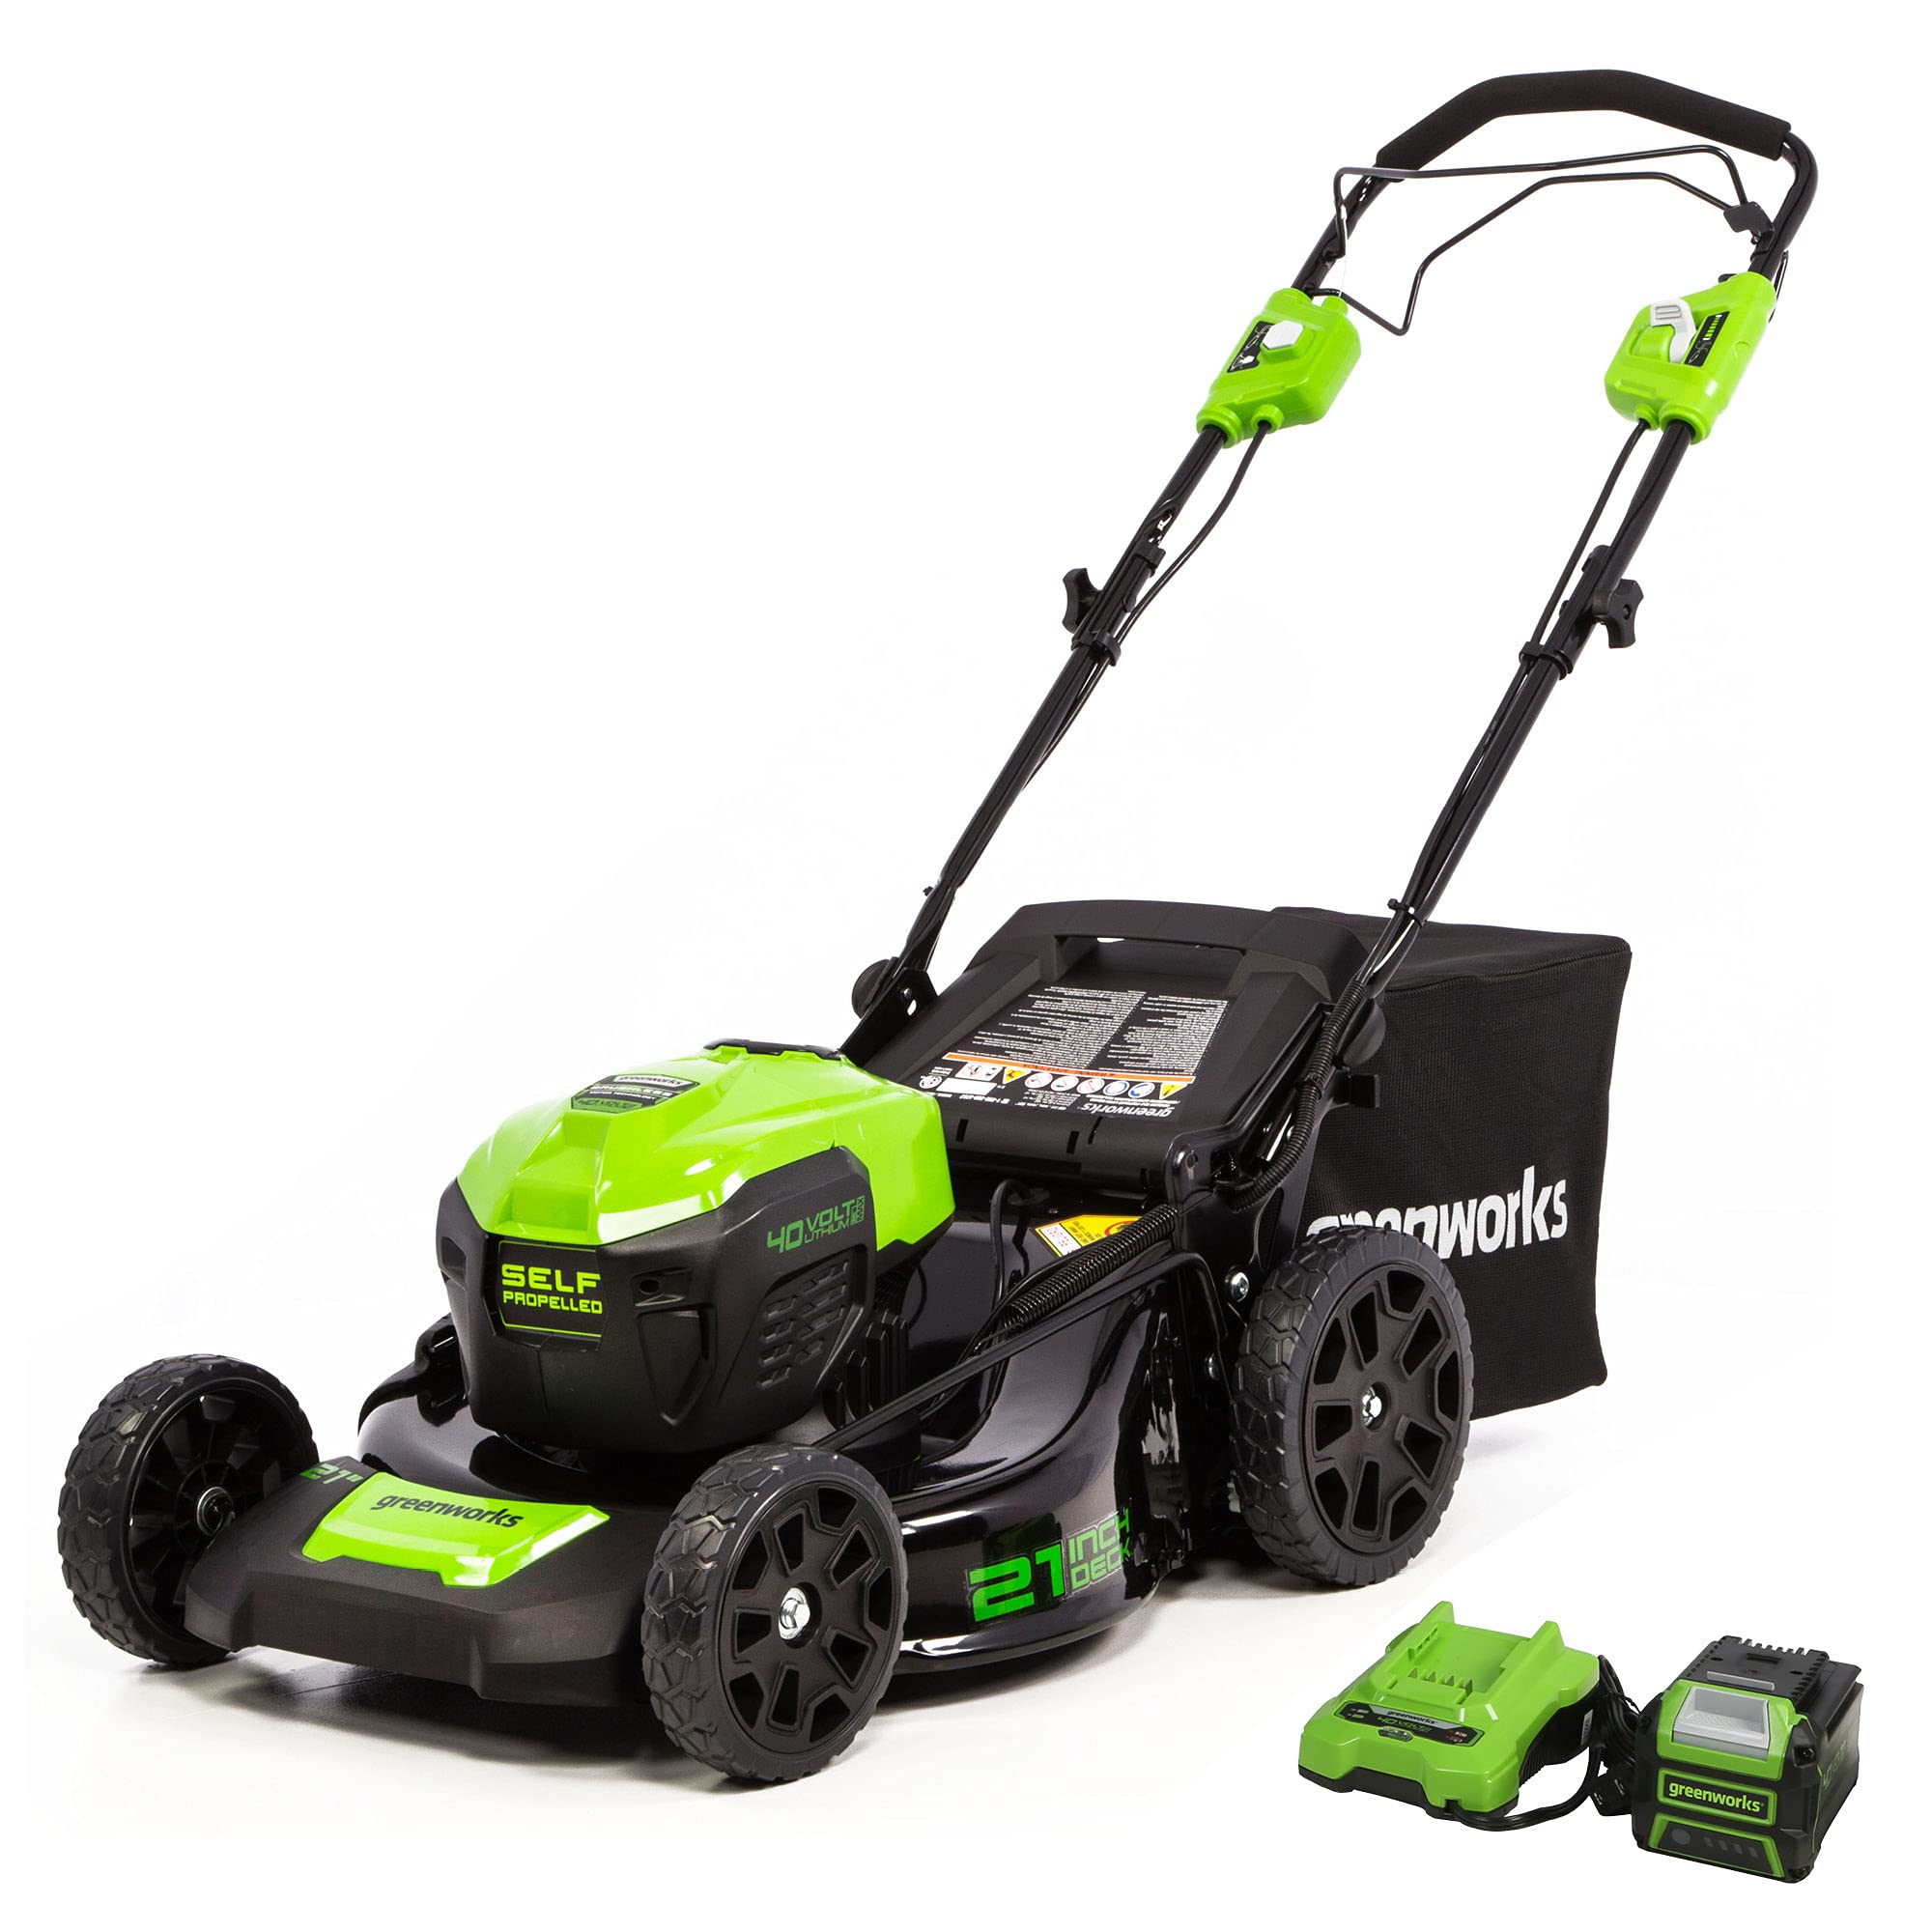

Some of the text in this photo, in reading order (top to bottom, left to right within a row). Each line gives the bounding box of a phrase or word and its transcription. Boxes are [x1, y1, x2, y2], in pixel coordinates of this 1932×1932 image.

[1081, 1103, 1175, 1118] greenworks
[766, 1199, 855, 1253] 40 VOLT
[1306, 1165, 1568, 1260] nworks
[804, 1217, 849, 1243] LITHIUM
[501, 1263, 601, 1294] SELF
[502, 1291, 603, 1315] PROPELLED
[370, 1494, 526, 1528] greenworks
[969, 1508, 1130, 1623] 21 INCH
[1071, 1537, 1132, 1590] DECK
[1387, 1710, 1437, 1725] greenworks
[1668, 1781, 1763, 1814] greenworks
